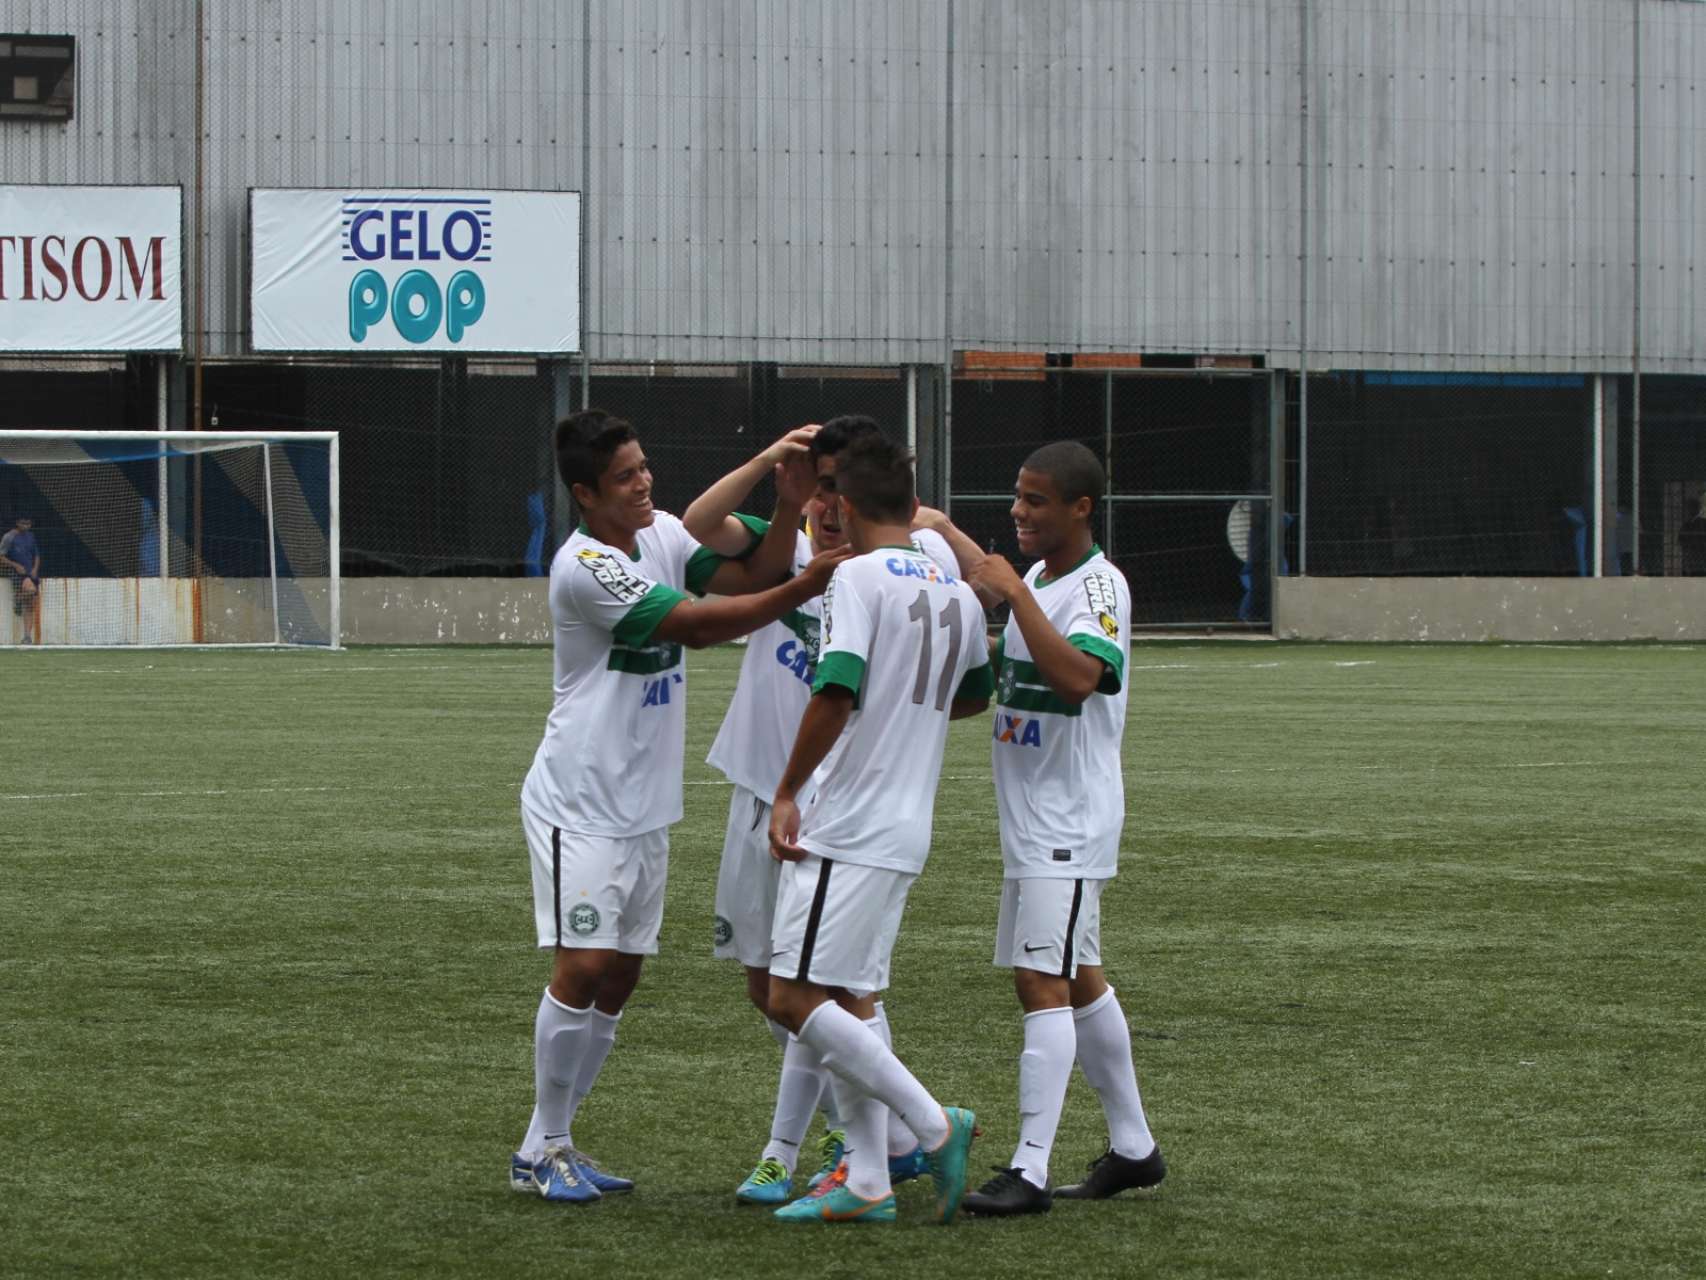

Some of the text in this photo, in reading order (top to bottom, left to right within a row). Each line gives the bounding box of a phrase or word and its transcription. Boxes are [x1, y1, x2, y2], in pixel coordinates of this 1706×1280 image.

[350, 210, 482, 261] GELO
[349, 268, 486, 344] POP
[908, 589, 962, 711] 11
